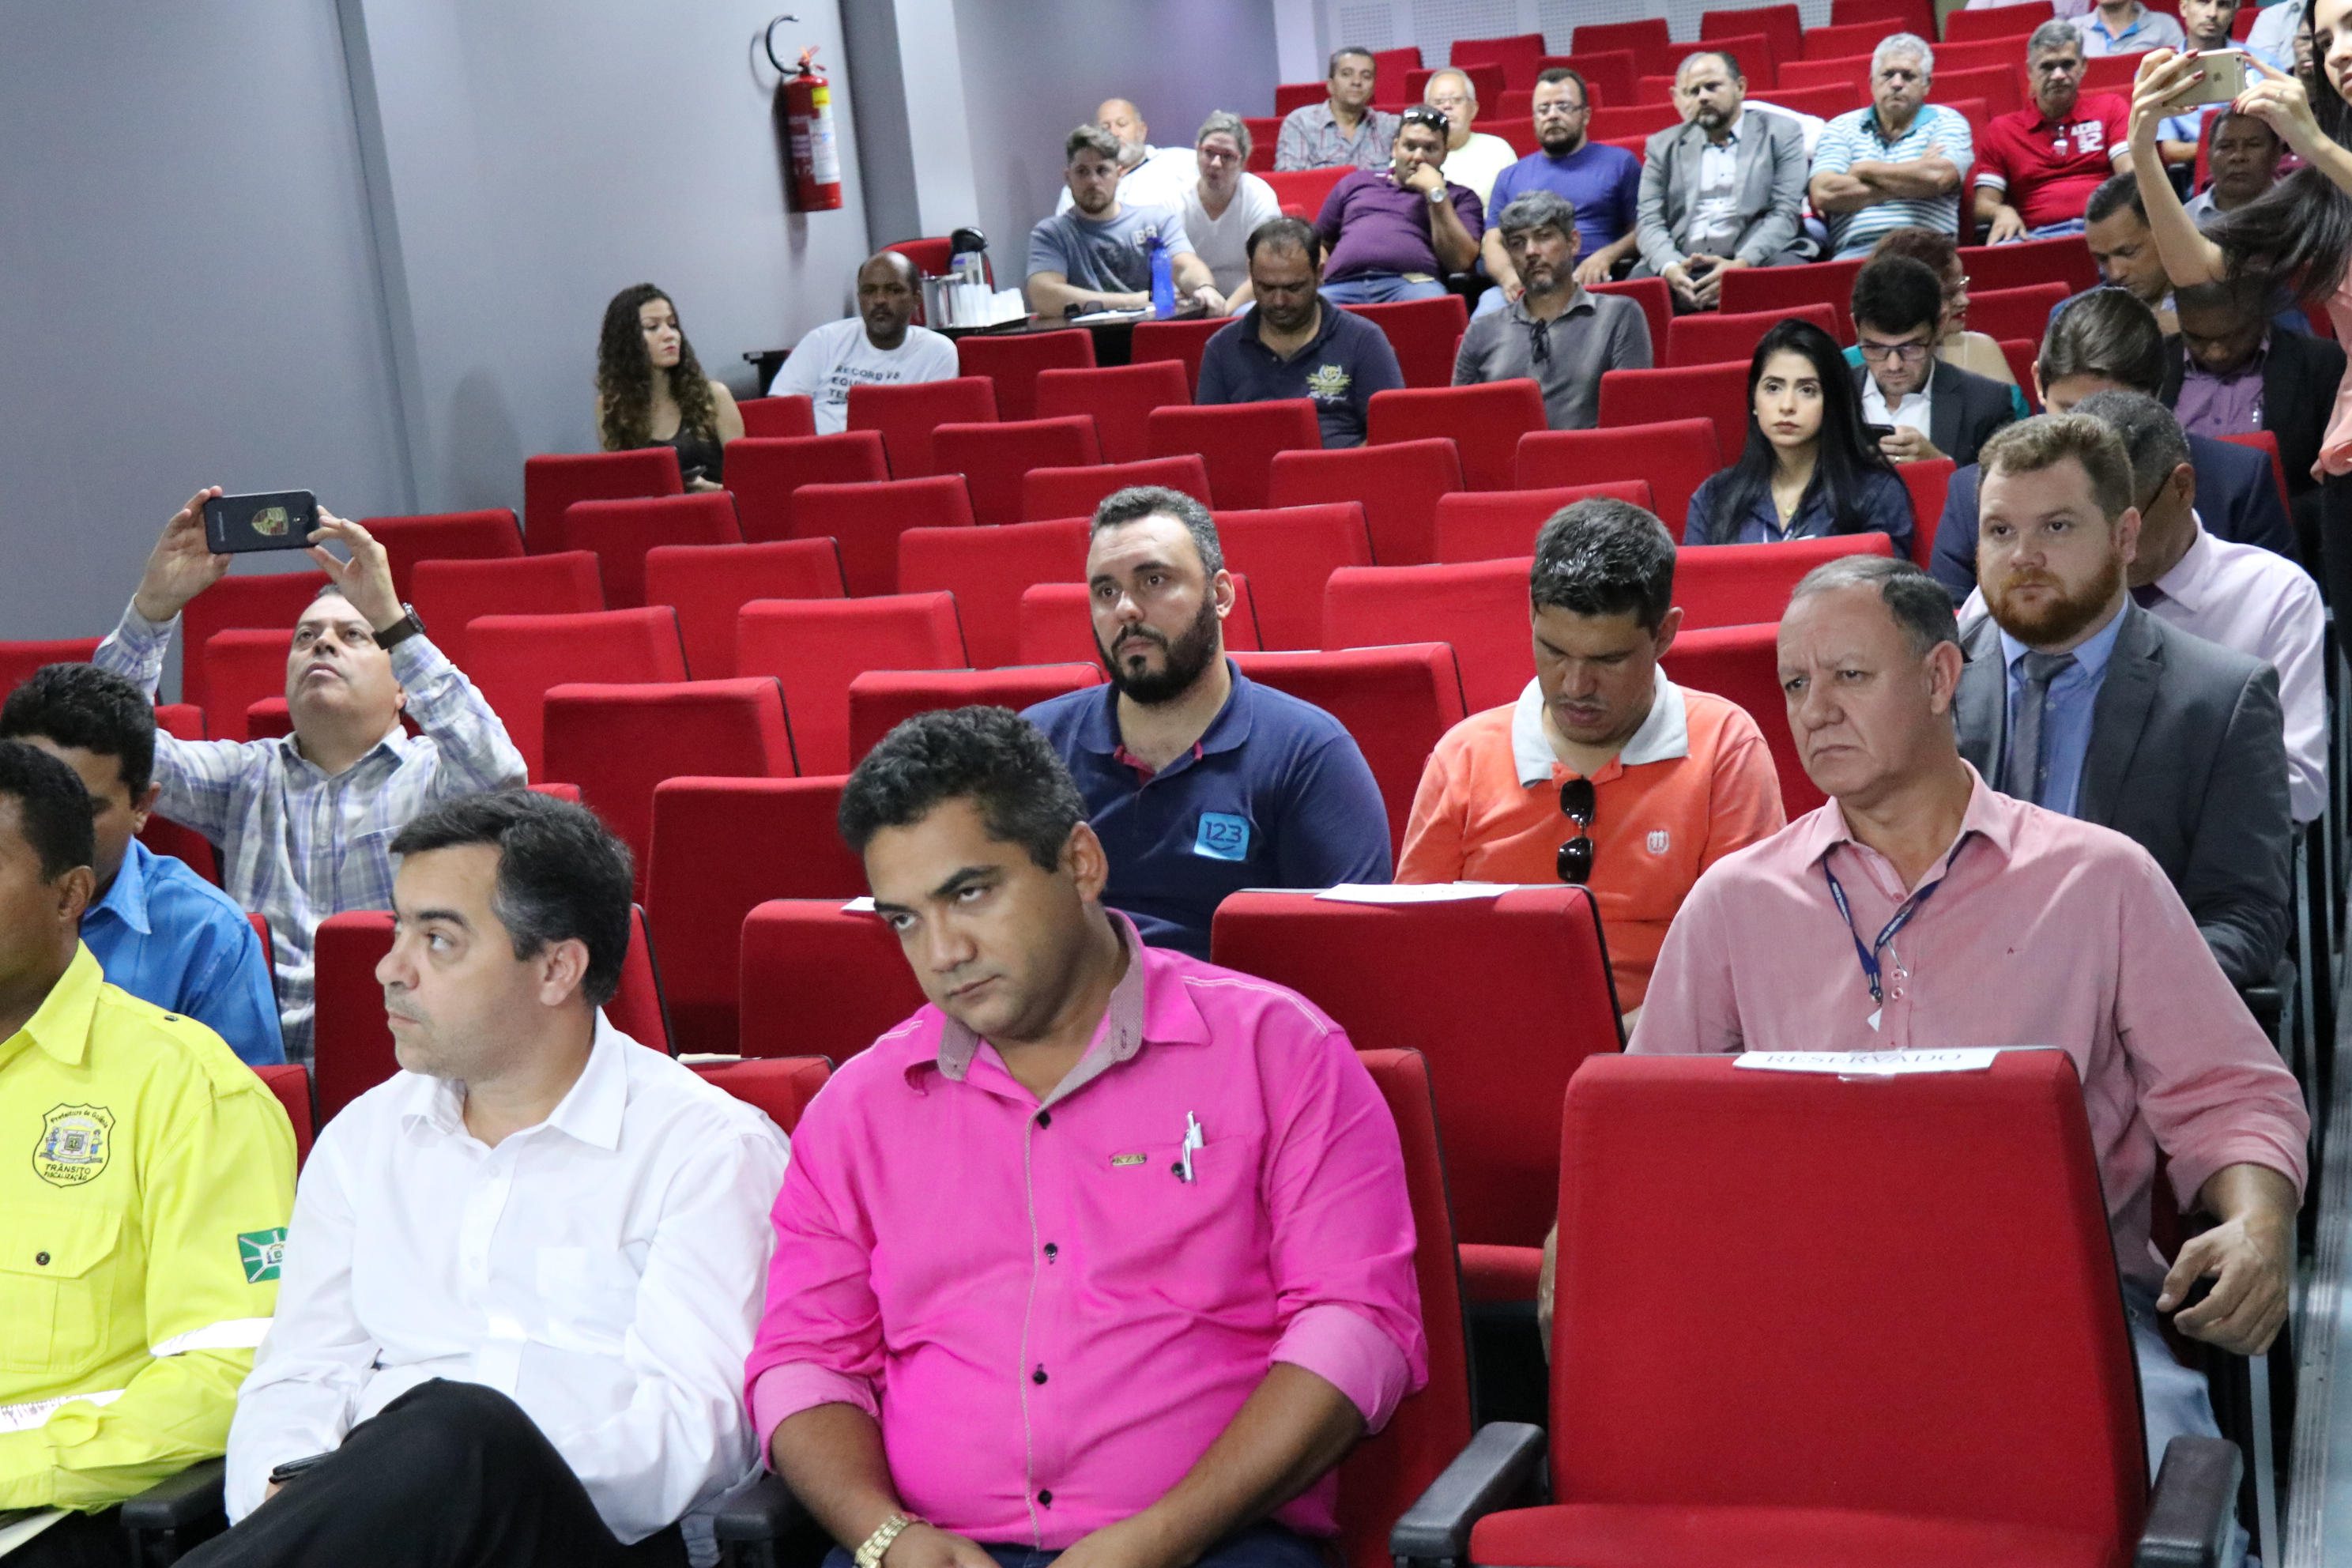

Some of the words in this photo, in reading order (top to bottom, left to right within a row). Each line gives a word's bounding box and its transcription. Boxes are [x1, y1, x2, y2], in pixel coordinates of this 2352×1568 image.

[835, 365, 884, 380] RECORD
[1205, 821, 1242, 843] 123
[1766, 1053, 1962, 1064] RESERVADO
[51, 1110, 82, 1123] Prefeitura
[46, 1163, 91, 1174] TRÂNSITO
[43, 1171, 87, 1182] FISCALIZAÇÃO
